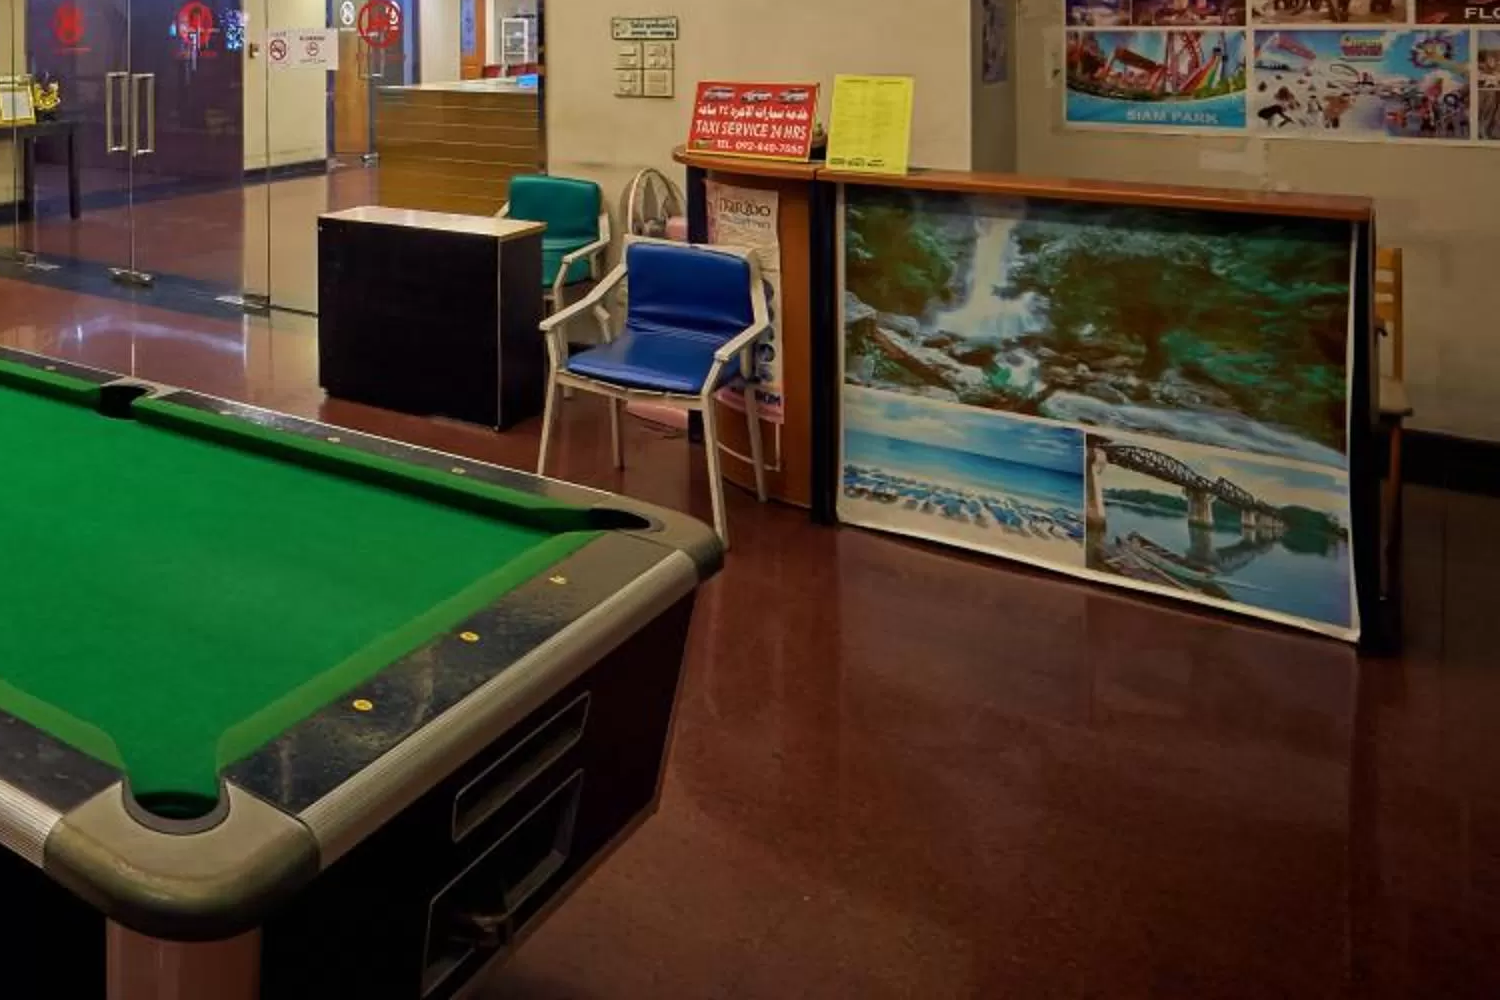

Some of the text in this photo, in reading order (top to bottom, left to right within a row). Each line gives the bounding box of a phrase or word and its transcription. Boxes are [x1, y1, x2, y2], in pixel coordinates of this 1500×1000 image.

[1126, 109, 1220, 125] SIAM PARK
[696, 119, 807, 141] TAXI SERVICE 24 HRS
